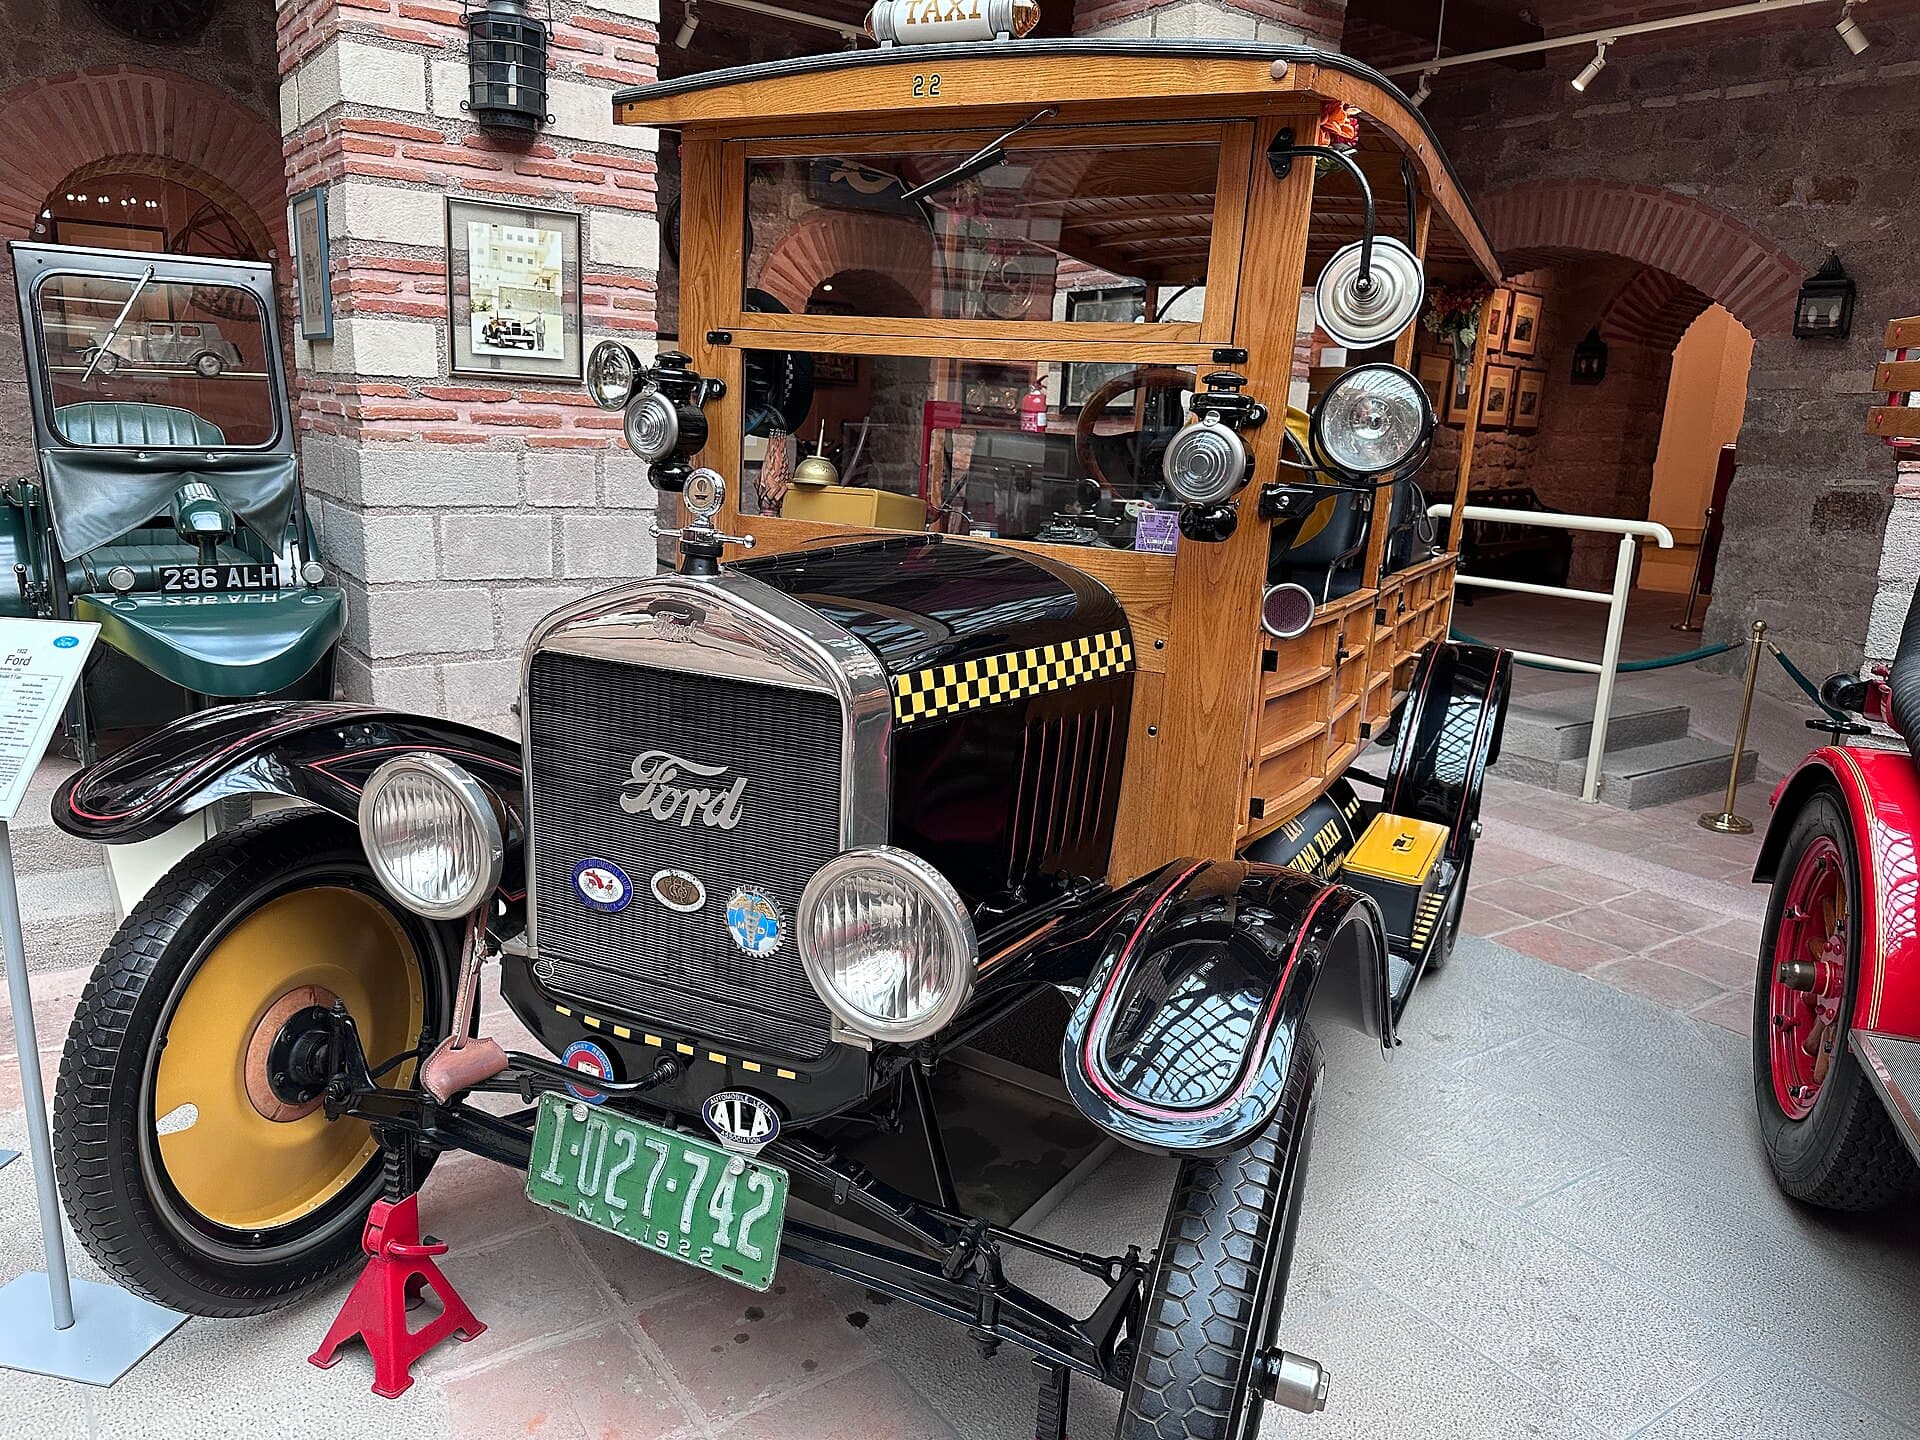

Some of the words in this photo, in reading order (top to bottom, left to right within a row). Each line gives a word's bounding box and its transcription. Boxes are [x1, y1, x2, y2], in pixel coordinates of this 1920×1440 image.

[904, 0, 982, 25] TAXI
[912, 73, 942, 98] 22
[163, 568, 218, 590] 236
[226, 566, 278, 588] ALH
[4, 654, 32, 666] Ford
[619, 750, 749, 830] Ford
[1313, 818, 1343, 856] TAXI
[710, 1093, 750, 1105] AUTOMOBILE
[753, 1100, 772, 1117] LEGAL
[713, 1100, 769, 1137] ALA
[720, 1129, 762, 1144] ASSOCIATION
[641, 1223, 715, 1267] 1922
